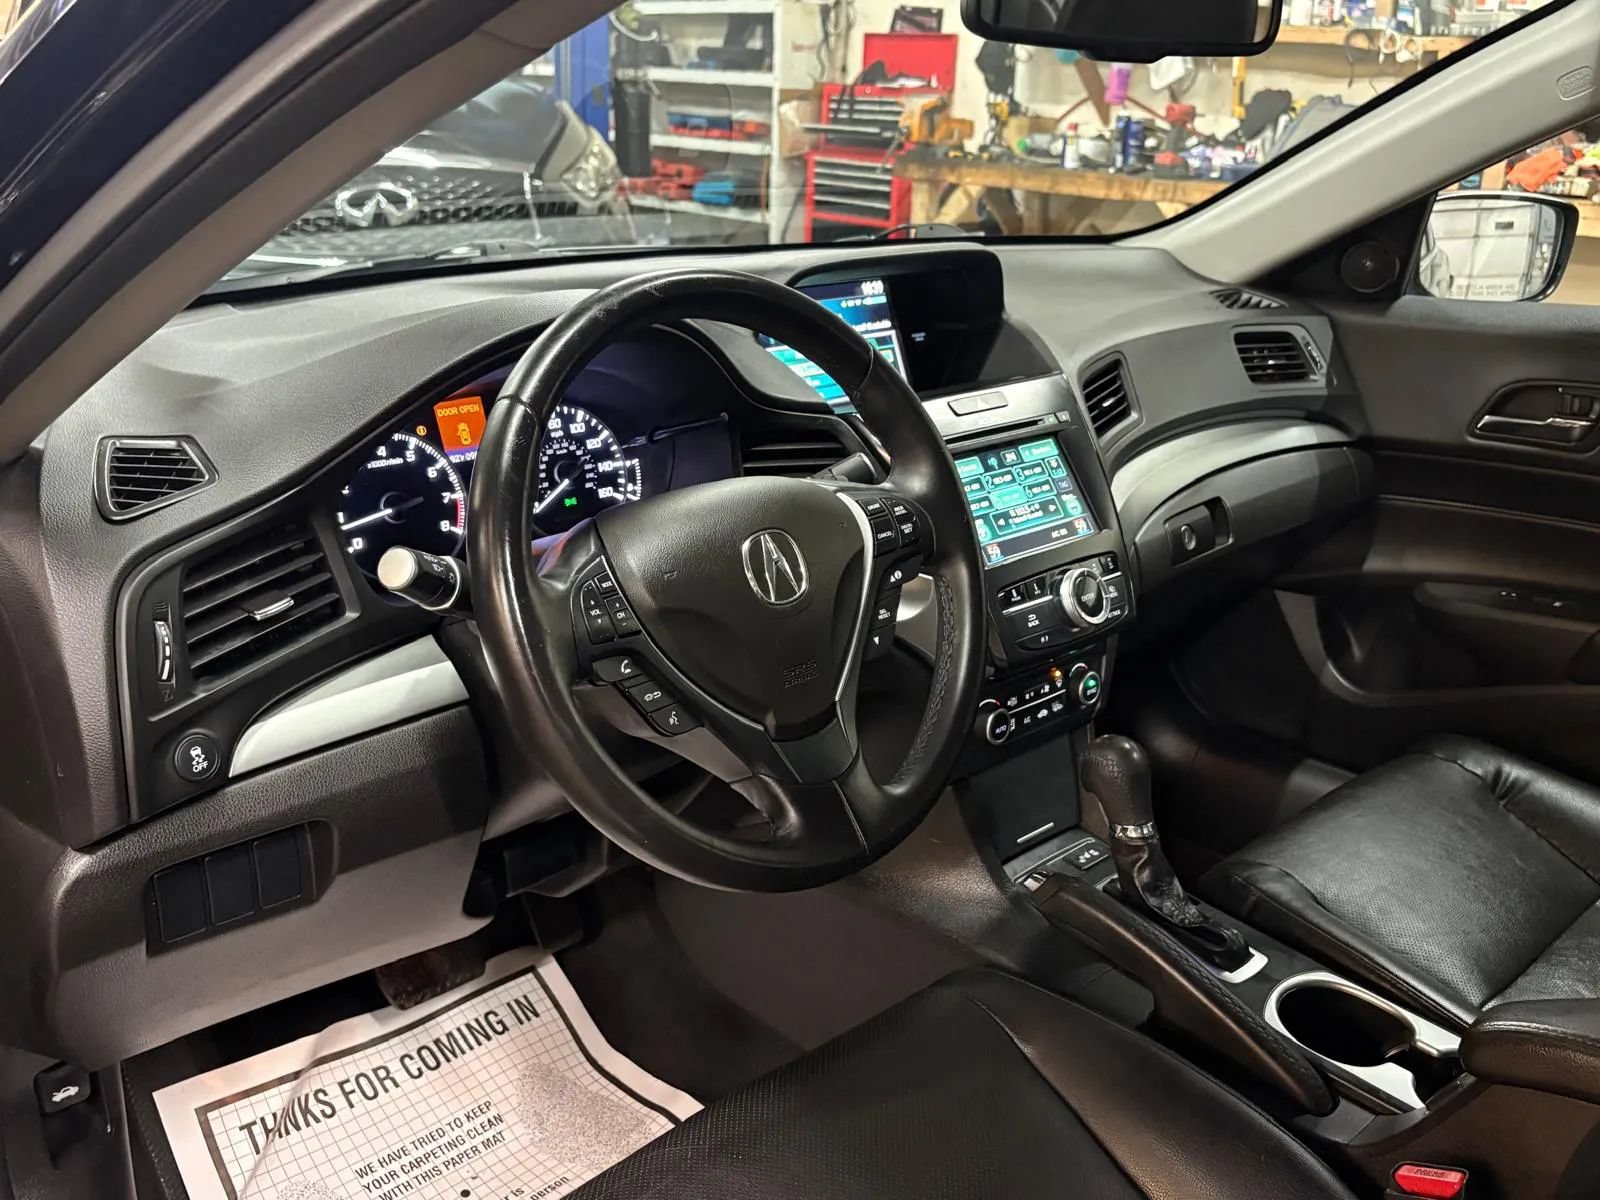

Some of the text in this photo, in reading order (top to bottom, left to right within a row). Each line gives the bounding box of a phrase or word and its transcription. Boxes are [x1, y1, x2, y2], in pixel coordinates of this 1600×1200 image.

[437, 404, 479, 416] DOOR OPEN
[569, 422, 585, 434] 100
[586, 438, 601, 449] 120
[376, 446, 386, 457] 4
[405, 450, 415, 462] 5
[427, 467, 437, 478] 6
[598, 461, 613, 473] 140
[1016, 468, 1025, 480] 3
[985, 475, 995, 489] 2
[441, 492, 450, 503] 7
[598, 487, 613, 498] 160
[1025, 487, 1033, 498] 6
[337, 512, 344, 523] 1
[440, 520, 450, 531] 8
[877, 531, 893, 539] CANCEL
[352, 538, 363, 549] 0
[1081, 592, 1095, 602] ENTER
[995, 725, 1007, 734] AUTO
[193, 760, 208, 772] OFF
[338, 1065, 401, 1109] FOR
[399, 1009, 510, 1080] COMING
[507, 994, 541, 1025] IN
[355, 1100, 492, 1179] WE HAVE TRIED TO KEEP
[362, 1113, 504, 1193] YOUR CARPETING CLEAN
[379, 1130, 507, 1200] WITH THIS PAPER MAT
[1414, 1168, 1445, 1178] PRESS
[511, 1188, 525, 1197] is
[530, 1175, 569, 1200] person
